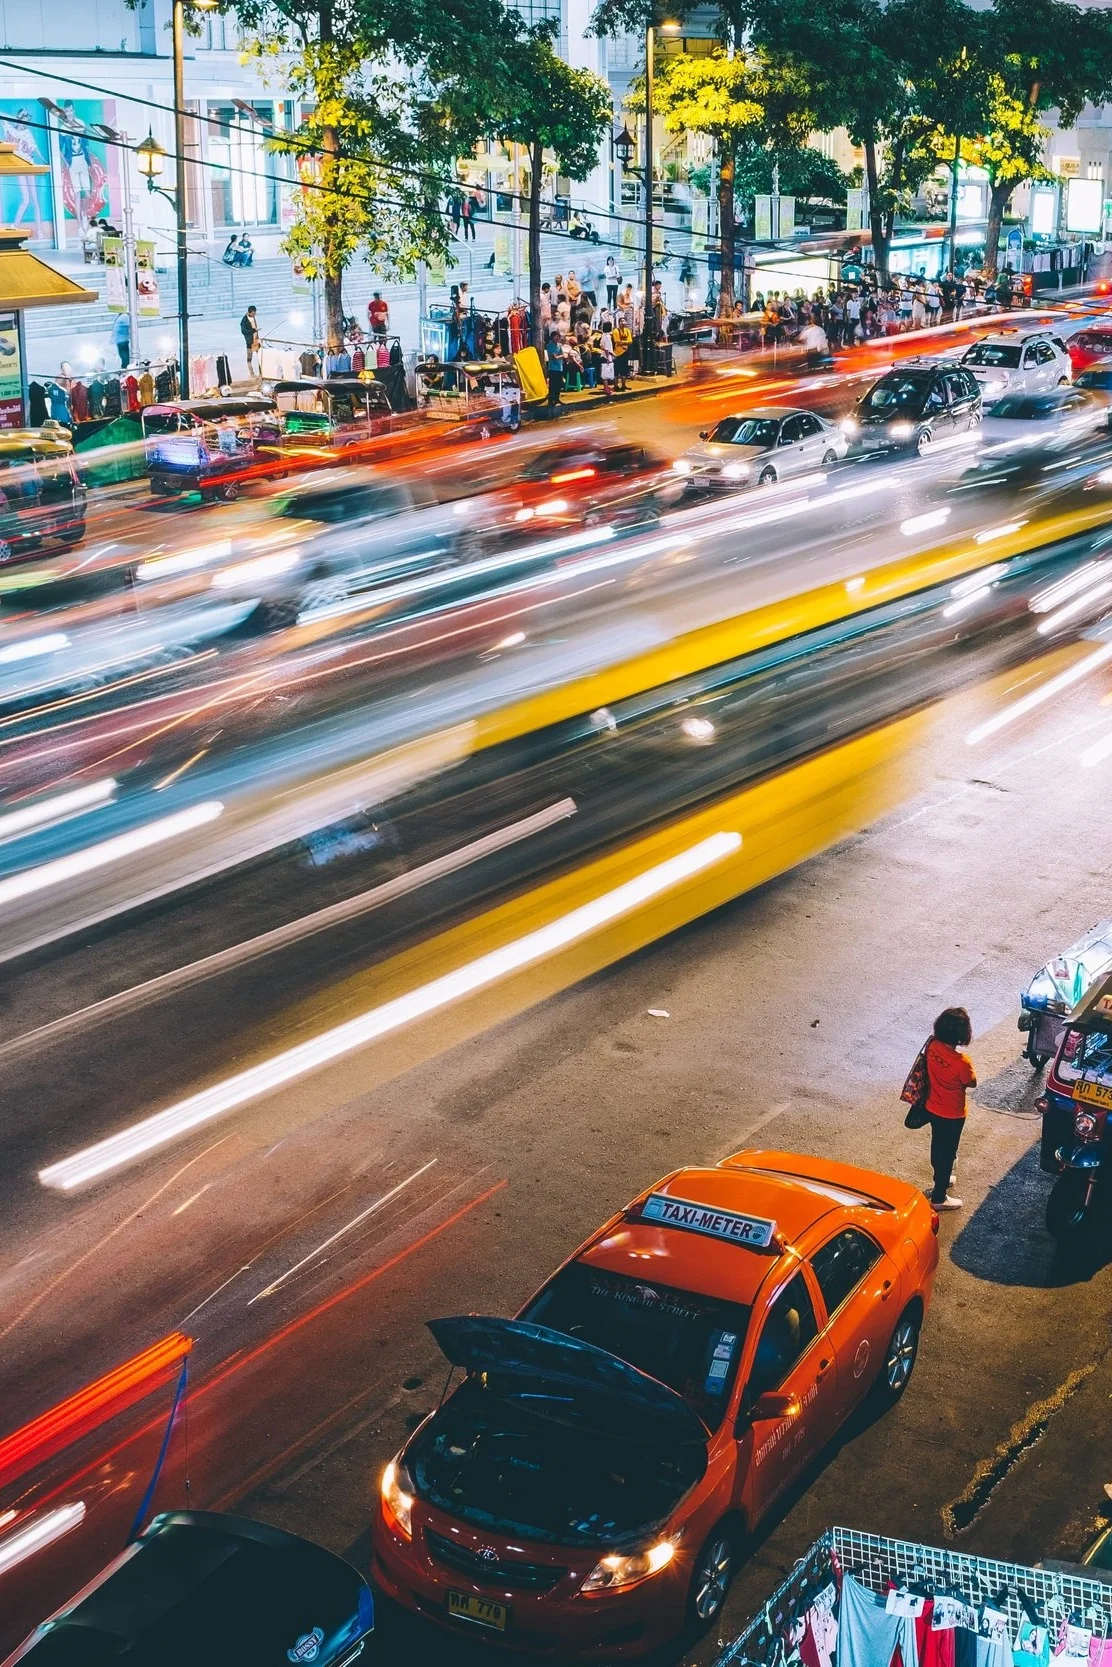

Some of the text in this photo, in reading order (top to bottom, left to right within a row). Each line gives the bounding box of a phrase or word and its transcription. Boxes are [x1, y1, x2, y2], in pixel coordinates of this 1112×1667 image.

[660, 1202, 754, 1240] TAXI-METER
[591, 1286, 701, 1321] THE KING OF STREET
[296, 1635, 318, 1657] BOSSY
